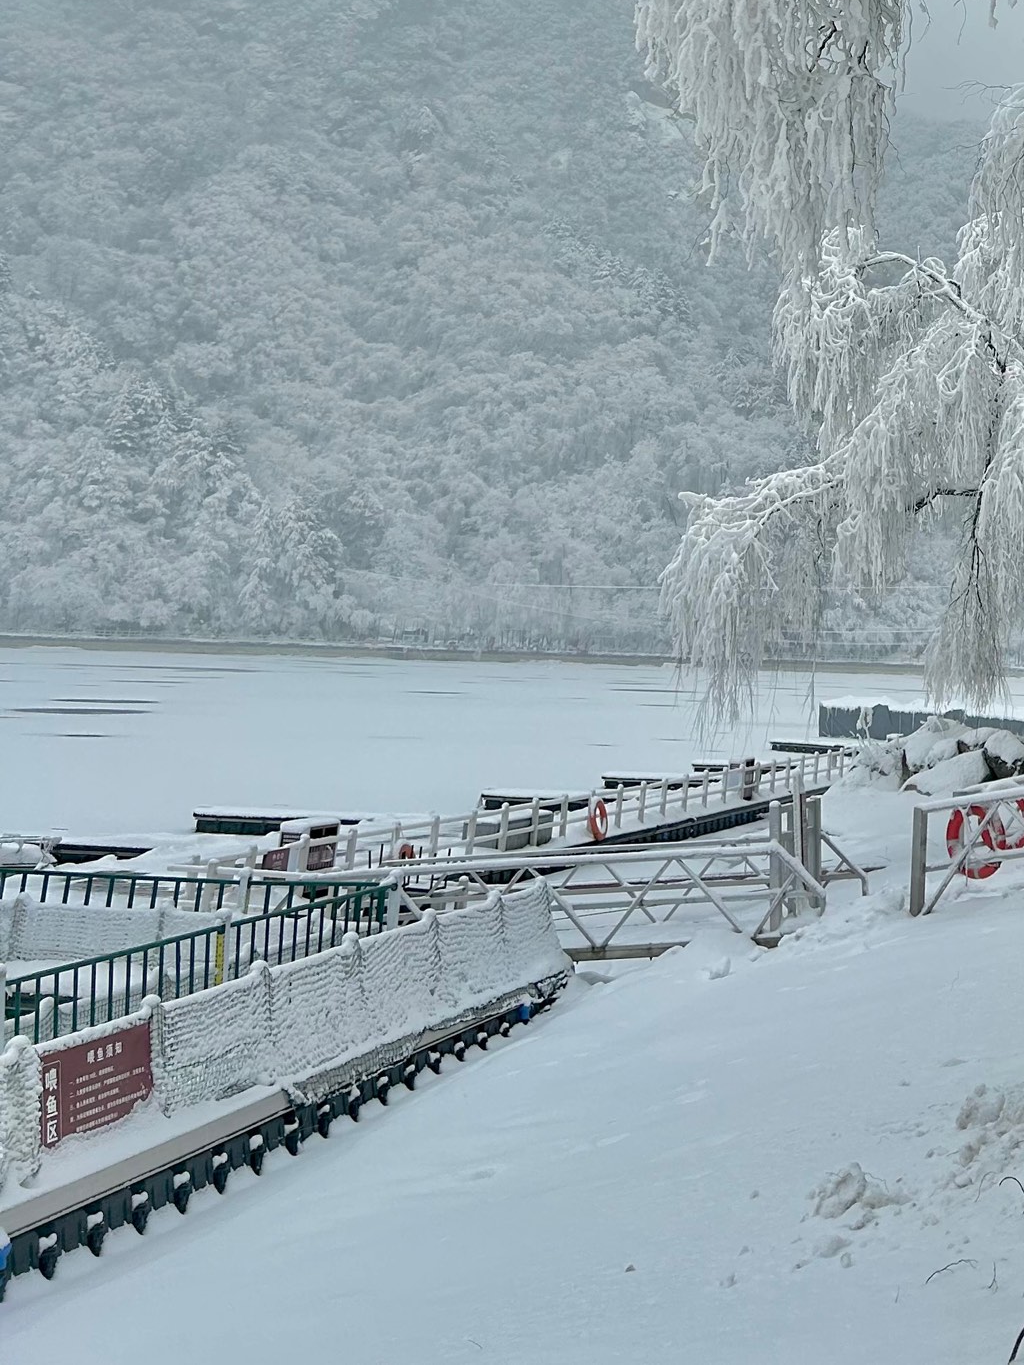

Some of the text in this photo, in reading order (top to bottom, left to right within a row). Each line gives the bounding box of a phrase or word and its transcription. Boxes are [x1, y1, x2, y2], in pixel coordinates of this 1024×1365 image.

[87, 1041, 123, 1064] 喂鱼须知
[45, 1067, 59, 1144] 喂鱼区
